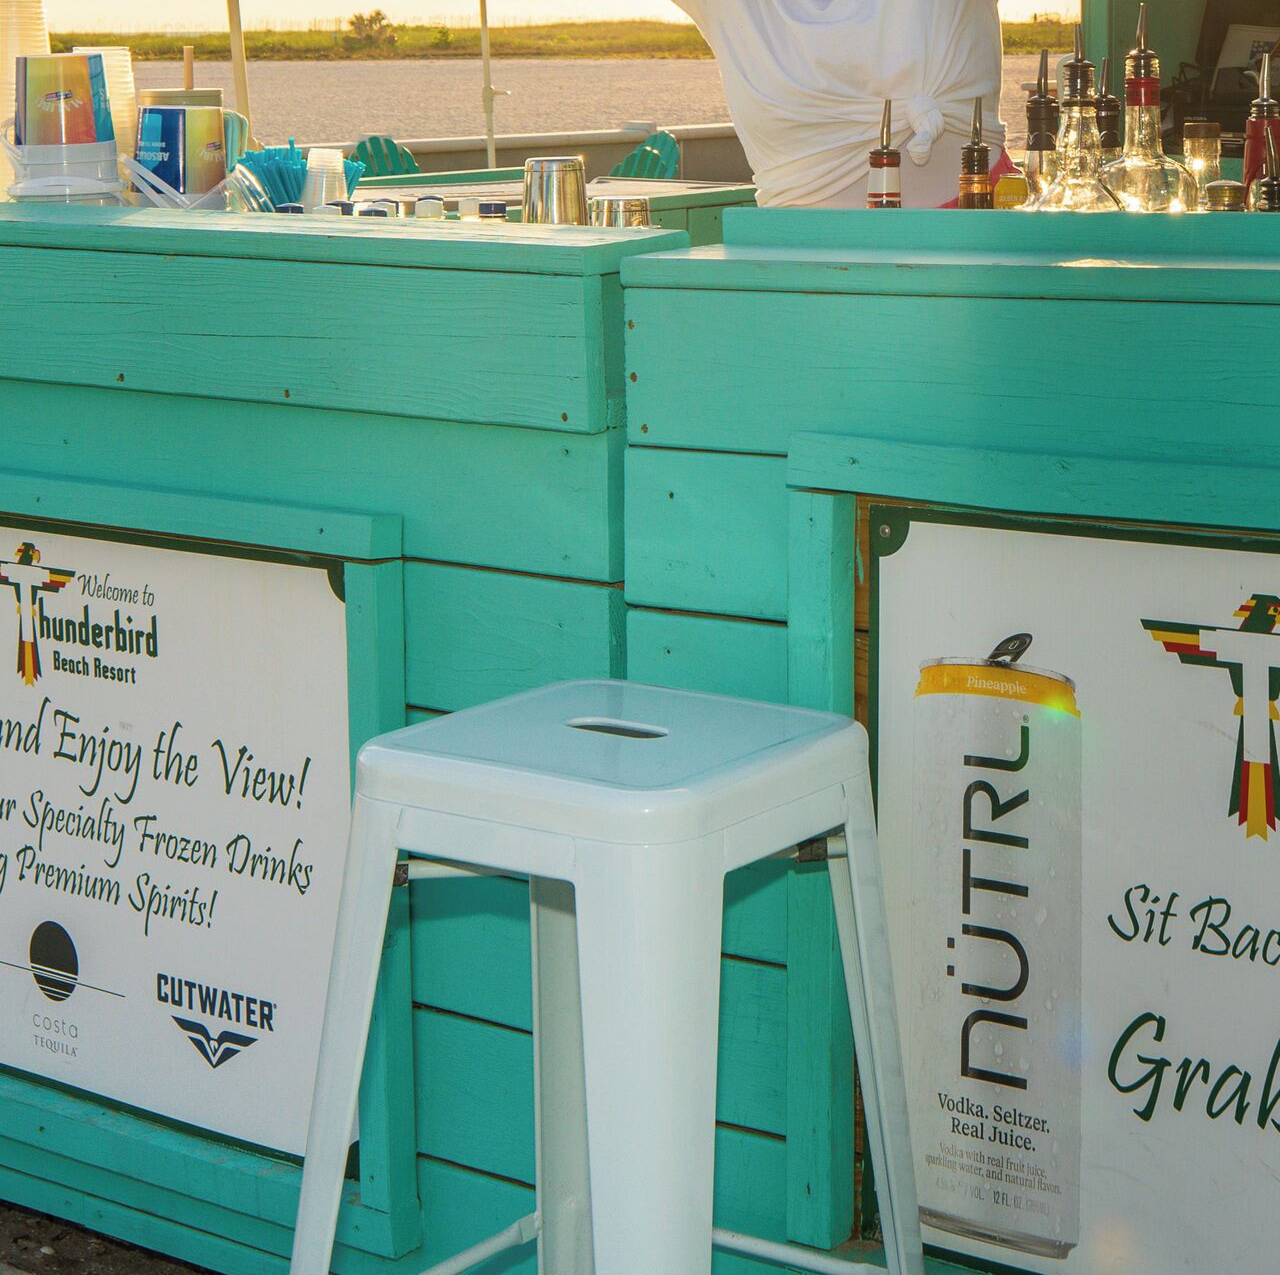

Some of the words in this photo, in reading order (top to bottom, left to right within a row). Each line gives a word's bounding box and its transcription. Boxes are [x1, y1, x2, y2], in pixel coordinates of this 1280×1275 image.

[77, 573, 139, 605] Welcome
[143, 584, 155, 607] to
[53, 650, 89, 677] Beach
[93, 657, 136, 685] Resort
[967, 675, 1027, 695] Pineapple
[52, 708, 144, 805] Enjoy
[153, 721, 199, 788] the
[211, 738, 312, 810] View!
[23, 789, 126, 869] Specialty
[133, 814, 218, 870] Frozen
[226, 832, 313, 896] Drinks
[16, 843, 121, 906] Premium
[127, 872, 219, 936] Spirits!
[1106, 883, 1180, 947] Sit
[157, 973, 274, 1032] CUTWATER
[32, 1013, 78, 1039] costa
[33, 1034, 78, 1058] TEQUILA
[938, 1092, 989, 1120] Vodka.
[993, 1104, 1050, 1134] Seltzer.
[951, 1117, 984, 1140] Real
[988, 1126, 1036, 1152] Juice.
[925, 1154, 957, 1172] sparkling
[959, 1162, 984, 1179] water,
[986, 1168, 1003, 1181] and
[1005, 1172, 1036, 1189] natural
[939, 1142, 964, 1157] Vodka
[966, 1150, 985, 1163] with
[987, 1155, 1004, 1168] real
[1006, 1157, 1025, 1173] fruit
